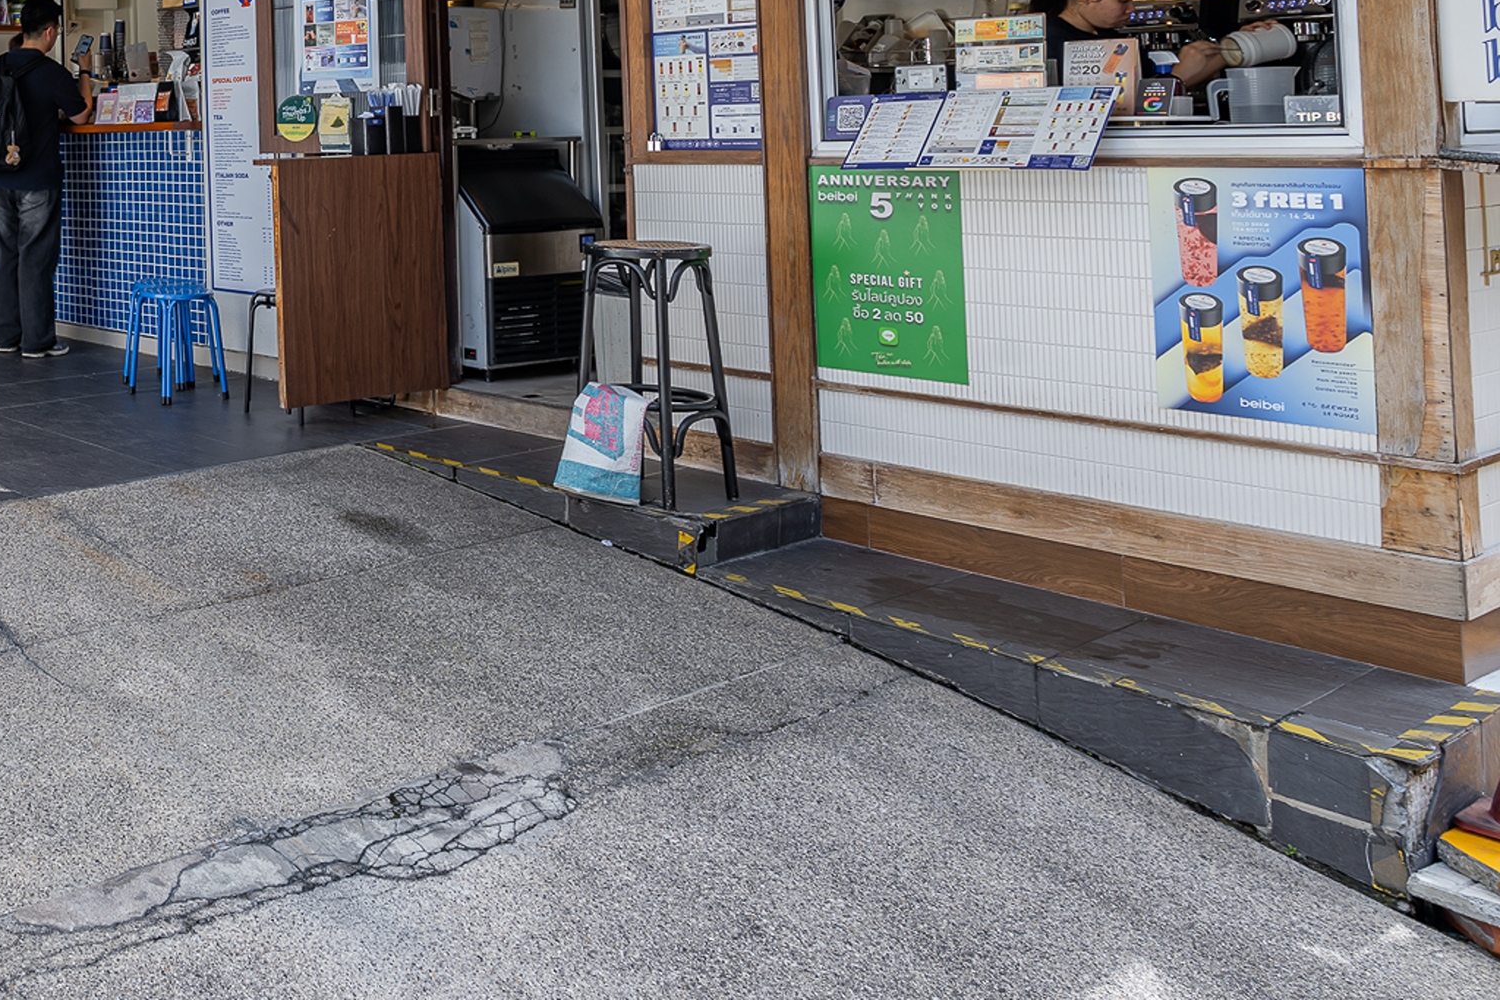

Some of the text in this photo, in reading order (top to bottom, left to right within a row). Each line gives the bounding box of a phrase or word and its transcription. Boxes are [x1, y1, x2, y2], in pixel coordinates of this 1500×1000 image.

[211, 8, 230, 16] COFFEE
[1082, 64, 1101, 75] 20
[1296, 112, 1322, 121] TIP
[817, 174, 951, 188] ANNIVERSARY
[817, 191, 858, 202] beibei
[1231, 191, 1248, 208] 3
[1329, 193, 1344, 210] 1
[870, 192, 893, 219] 5
[917, 202, 952, 210] YOU
[1289, 212, 1300, 220] 14
[850, 273, 894, 287] SPECIAL
[851, 288, 923, 307] รับไลน์คูปอง
[853, 304, 924, 324] ซื้อ 2 ลด 50
[1240, 398, 1285, 411] beibei
